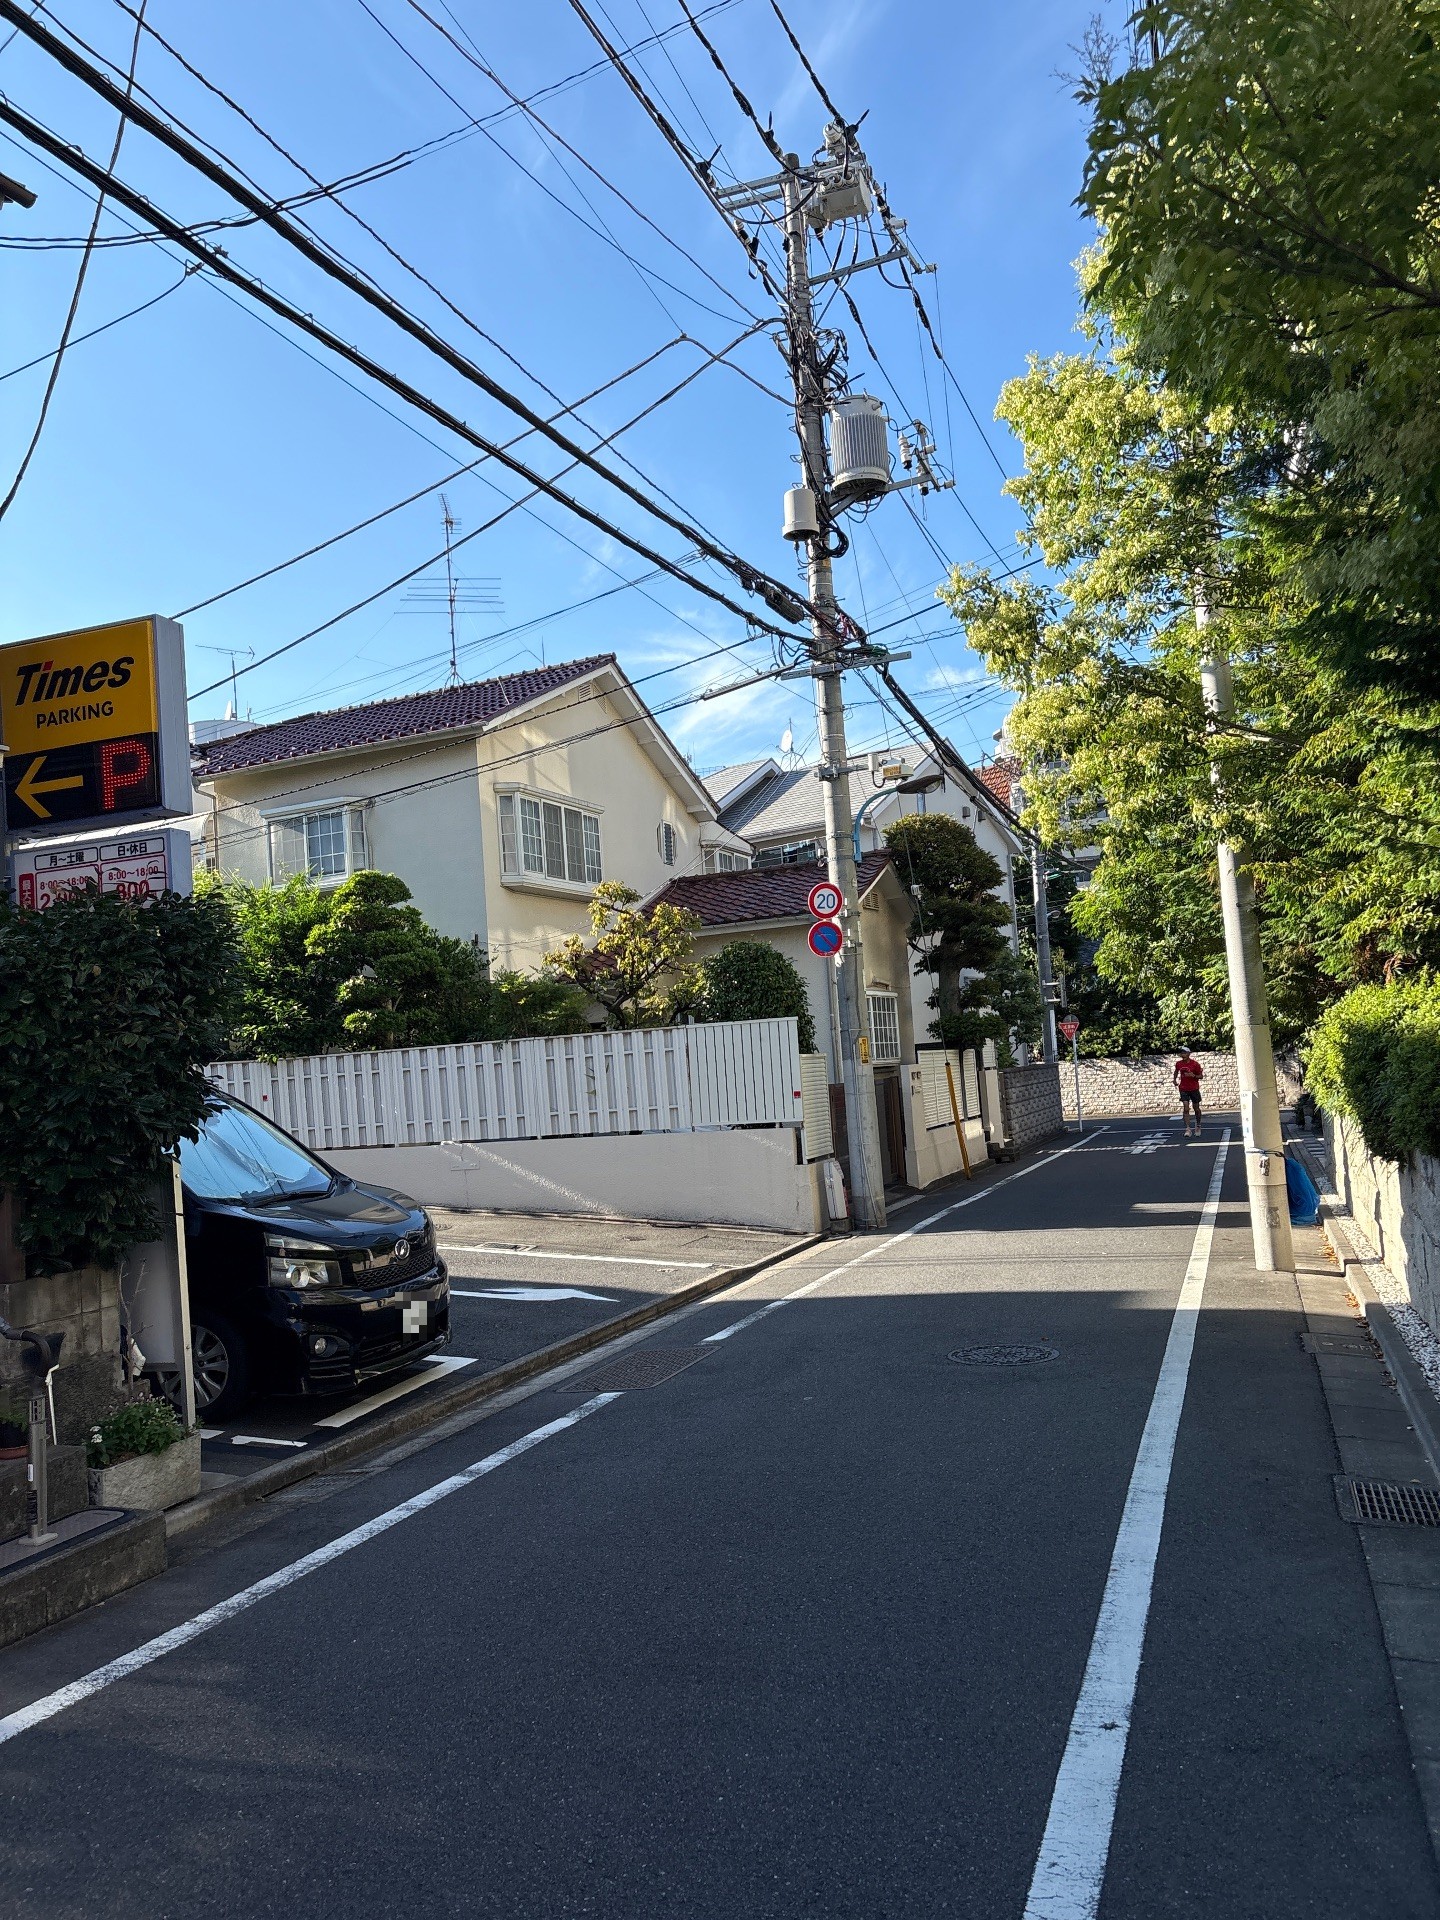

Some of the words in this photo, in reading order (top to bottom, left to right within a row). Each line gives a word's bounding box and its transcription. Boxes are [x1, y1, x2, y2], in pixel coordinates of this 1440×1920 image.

[15, 656, 135, 706] Times
[36, 701, 114, 729] PARKING
[102, 740, 150, 809] P
[816, 893, 836, 909] 20
